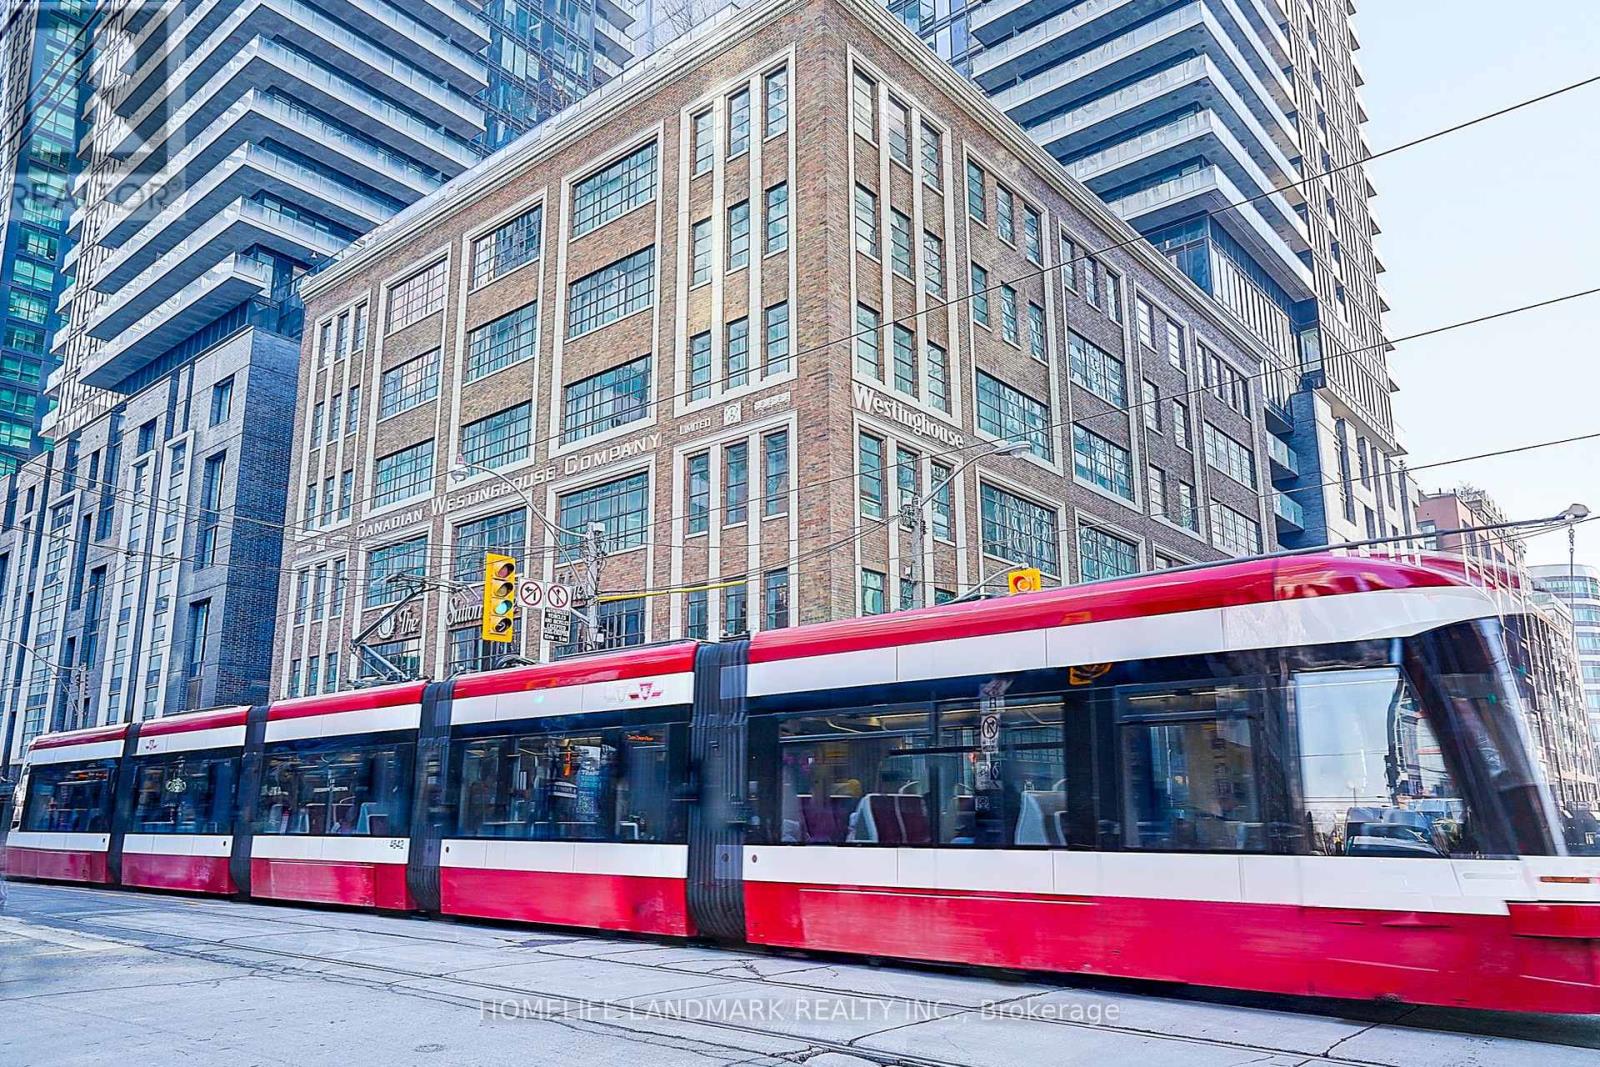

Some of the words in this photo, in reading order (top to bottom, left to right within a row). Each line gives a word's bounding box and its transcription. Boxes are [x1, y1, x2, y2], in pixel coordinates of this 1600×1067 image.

[853, 382, 964, 448] Westinghouse
[355, 509, 423, 539] CANADIAN
[431, 467, 556, 515] WESTINGHOUSE
[564, 433, 661, 475] COMPANY
[399, 607, 420, 633] The
